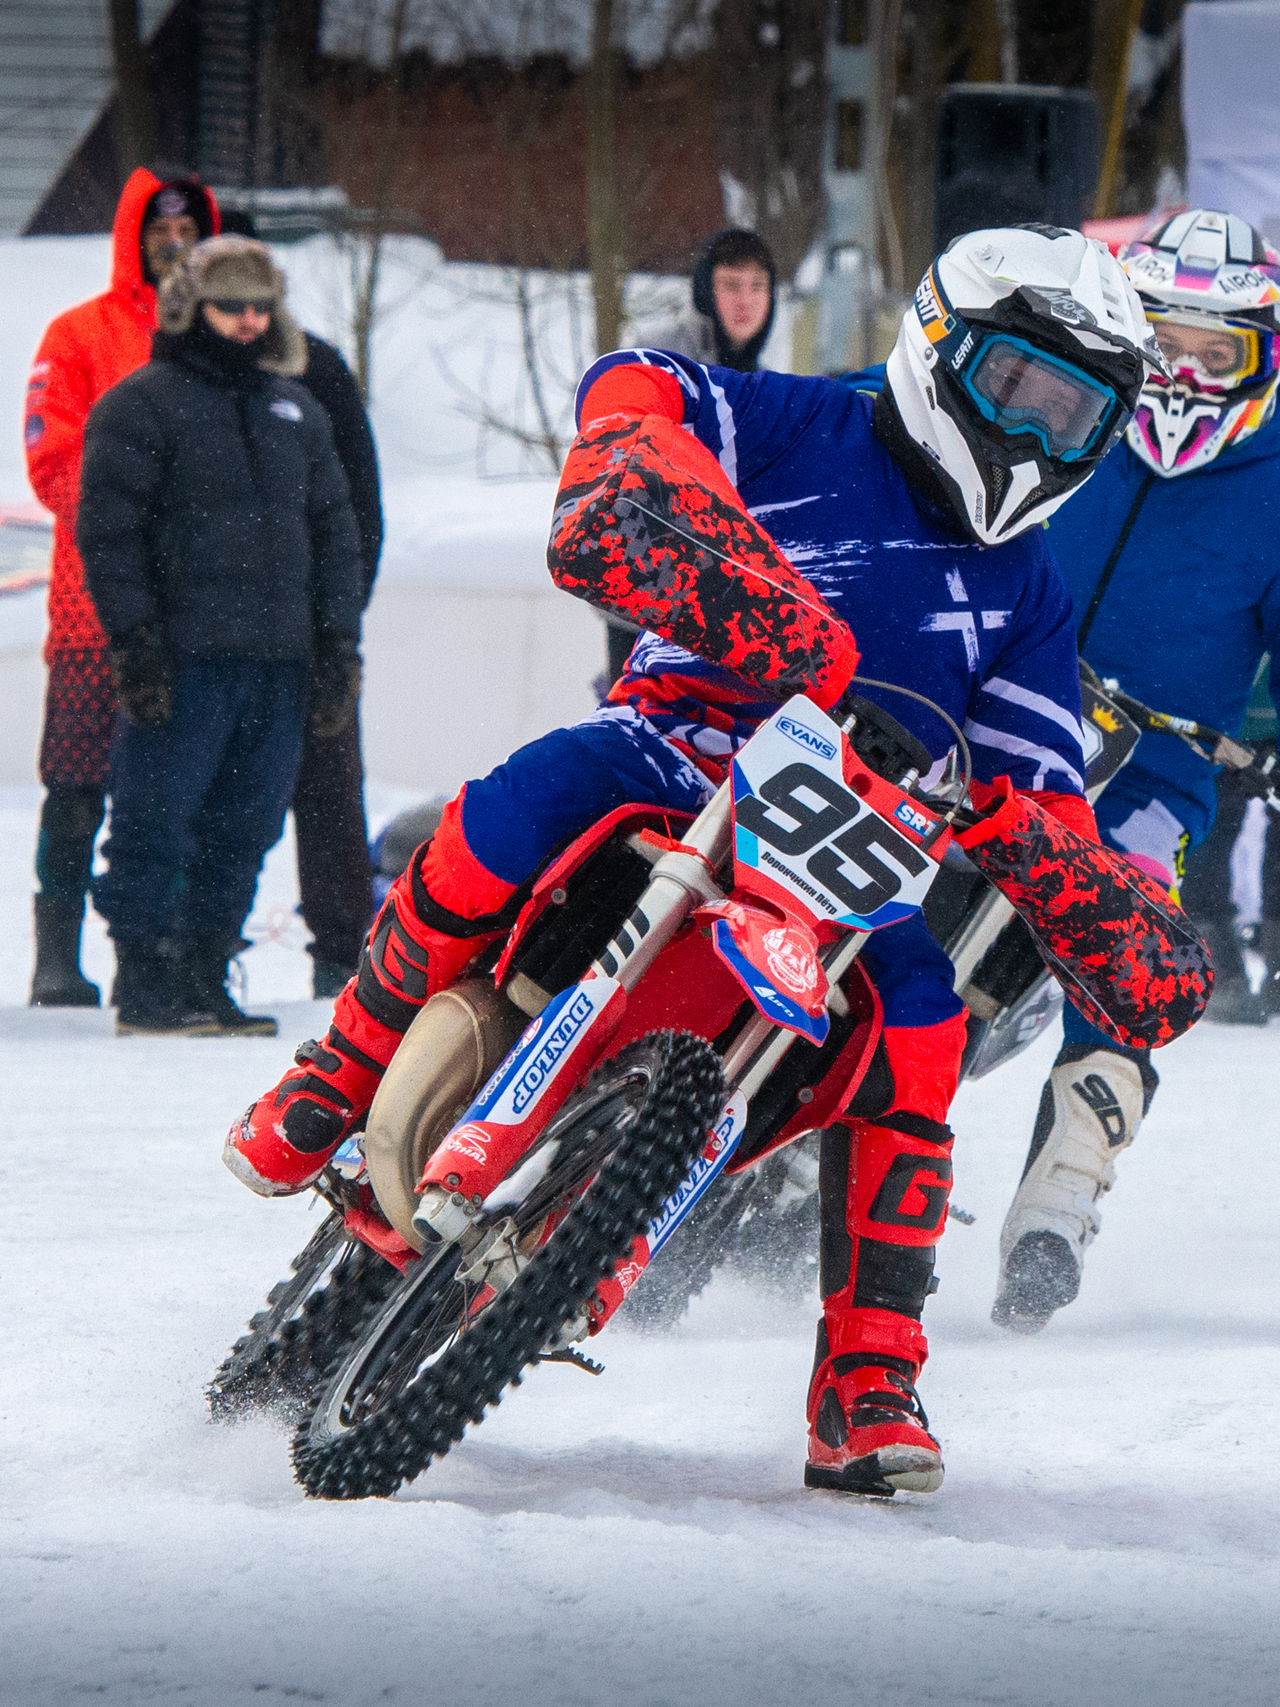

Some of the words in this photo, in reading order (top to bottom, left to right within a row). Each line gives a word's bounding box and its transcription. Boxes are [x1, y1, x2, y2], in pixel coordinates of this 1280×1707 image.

[951, 331, 974, 370] LEATT
[779, 720, 834, 758] EVANS
[734, 762, 930, 916] 95
[760, 851, 818, 899] Ворончихин
[815, 892, 838, 916] Пётр
[767, 995, 795, 1018] UFO
[513, 991, 594, 1114] DUNLOP
[650, 1116, 735, 1238] DUNLP
